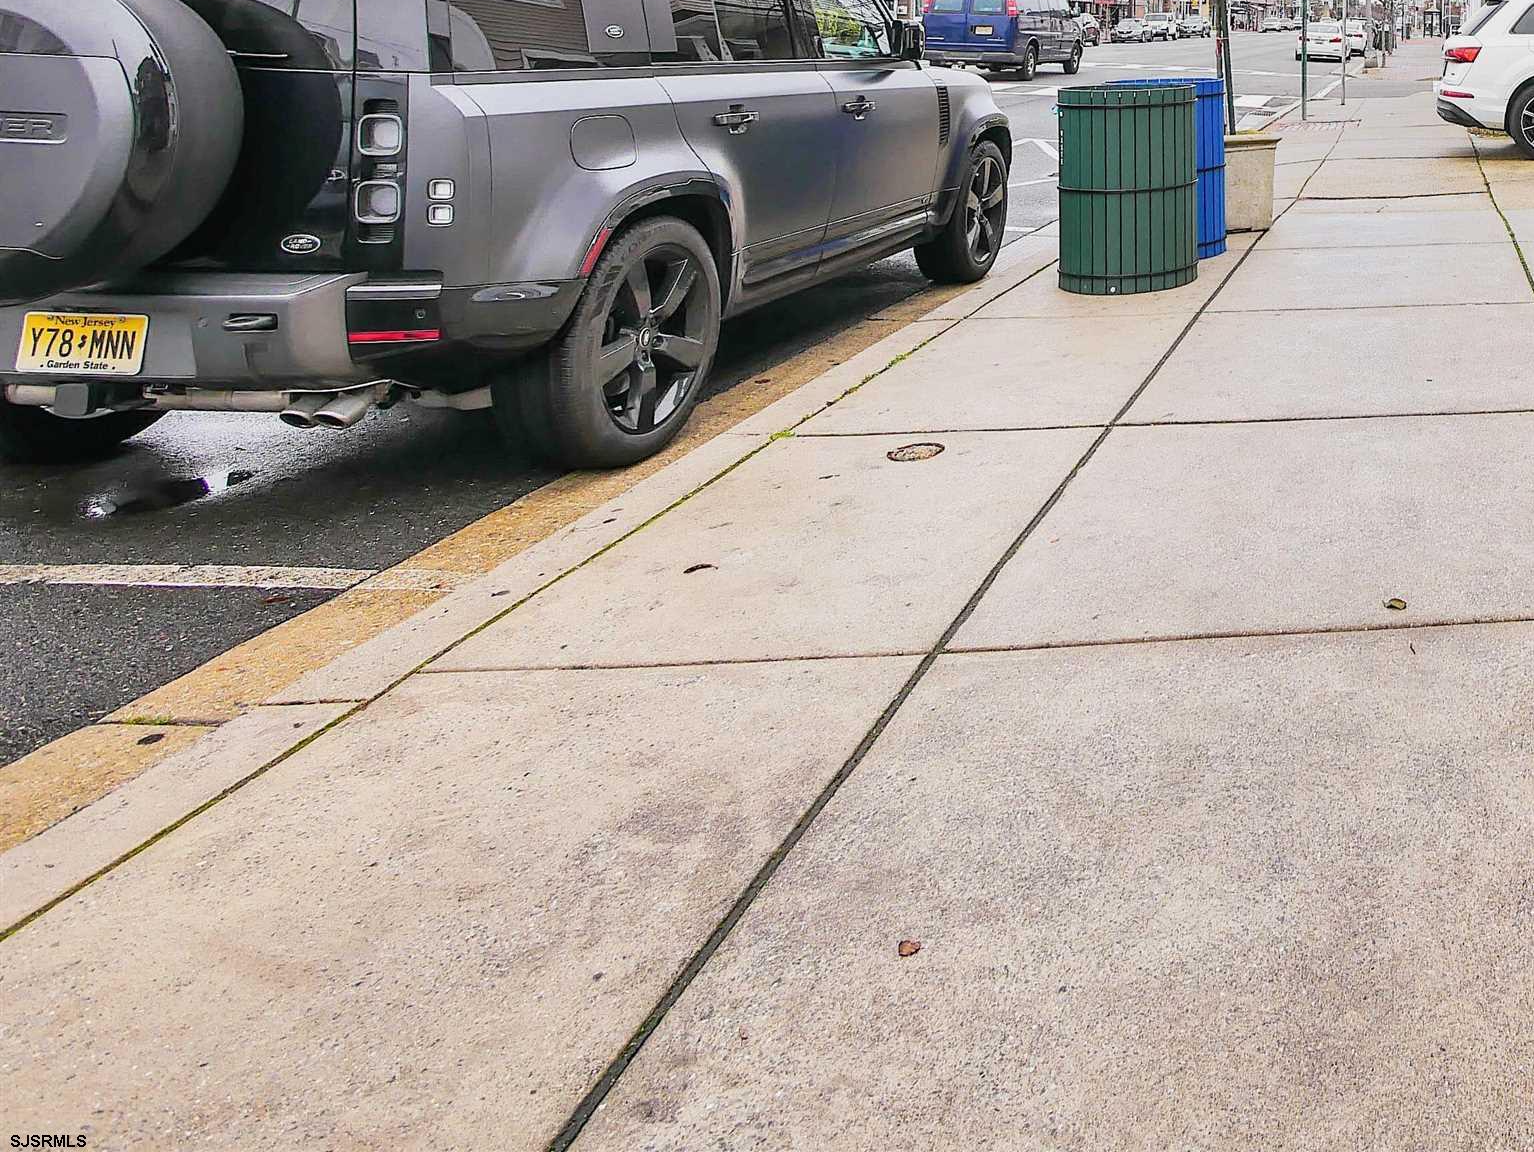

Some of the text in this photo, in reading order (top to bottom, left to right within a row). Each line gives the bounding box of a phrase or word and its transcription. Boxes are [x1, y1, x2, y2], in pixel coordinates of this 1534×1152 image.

[0, 117, 53, 136] ER
[54, 315, 117, 328] New Jersey
[31, 328, 137, 360] Y78 MNN
[46, 359, 109, 370] Garden State
